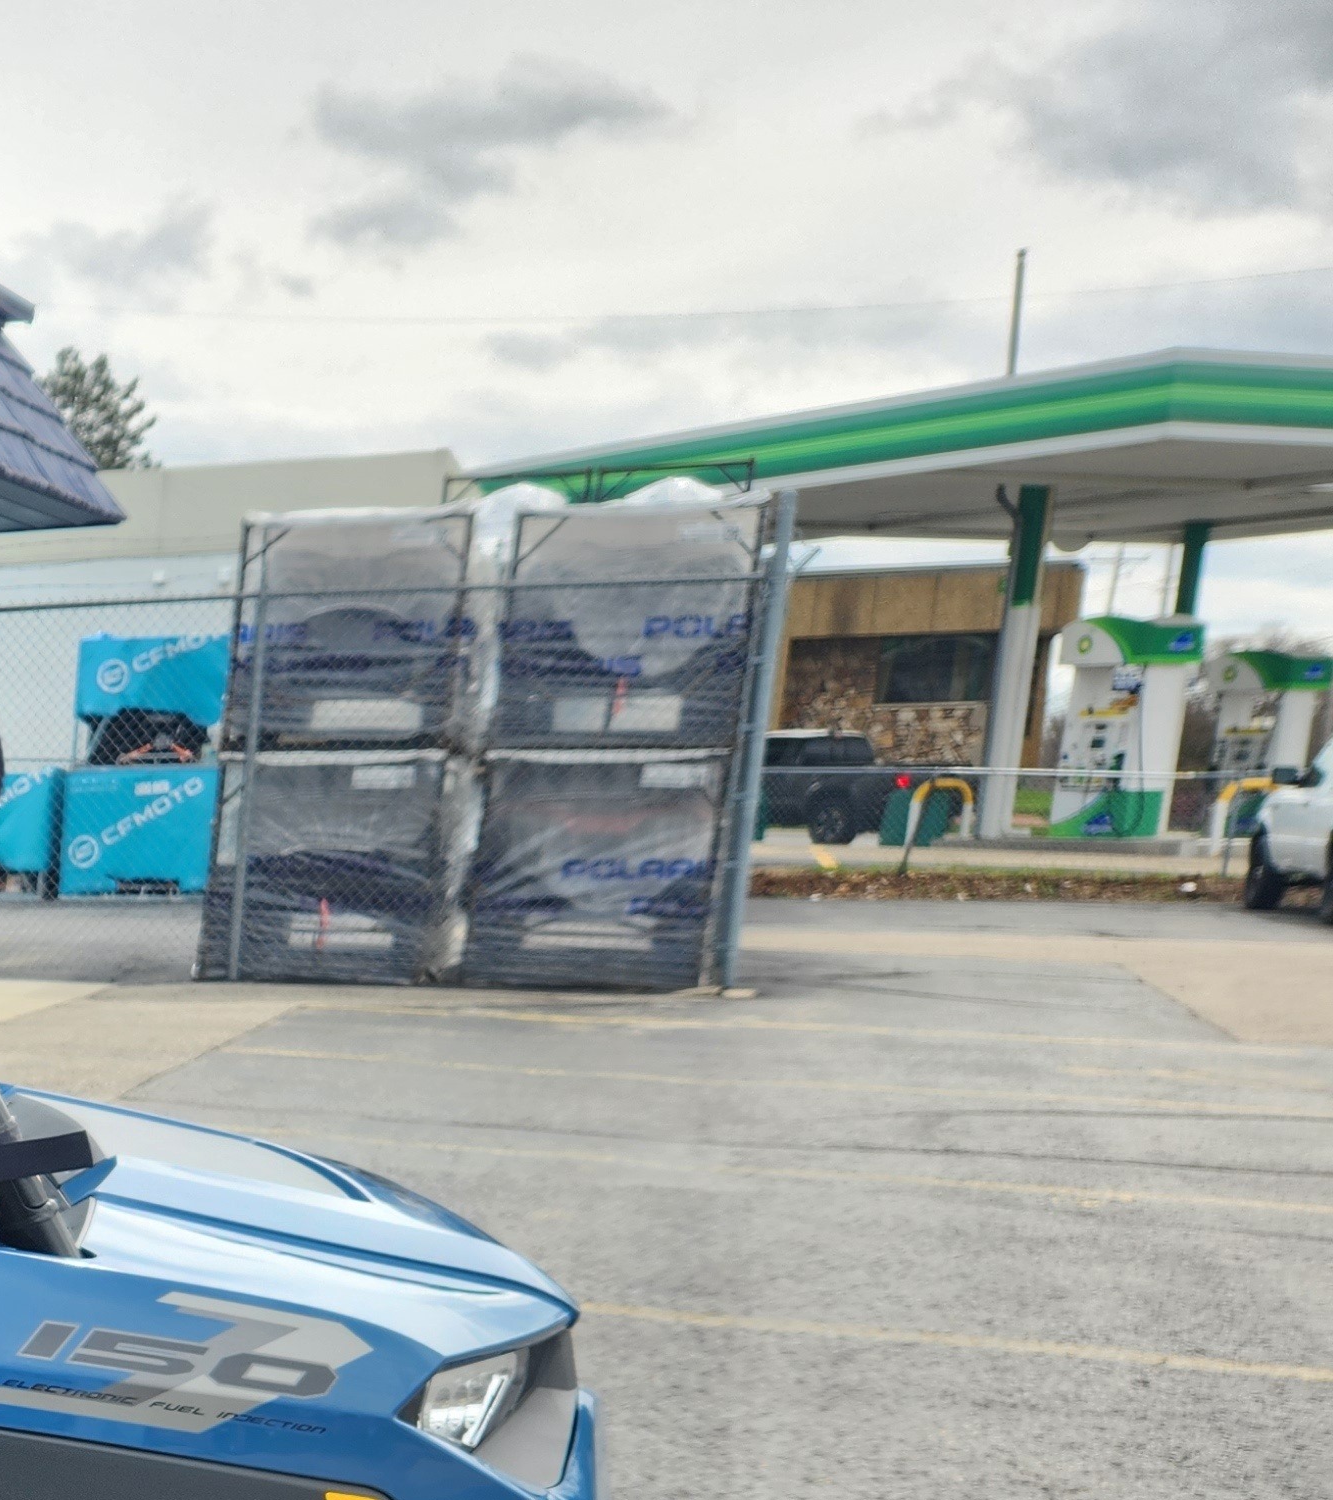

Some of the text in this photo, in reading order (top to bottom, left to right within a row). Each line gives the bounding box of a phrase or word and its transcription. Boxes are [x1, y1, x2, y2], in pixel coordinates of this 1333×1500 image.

[101, 775, 205, 846] CFMOTO
[16, 1319, 337, 1399] 150
[2, 1379, 327, 1435] ELECTRONIC FUEL INJECTION
